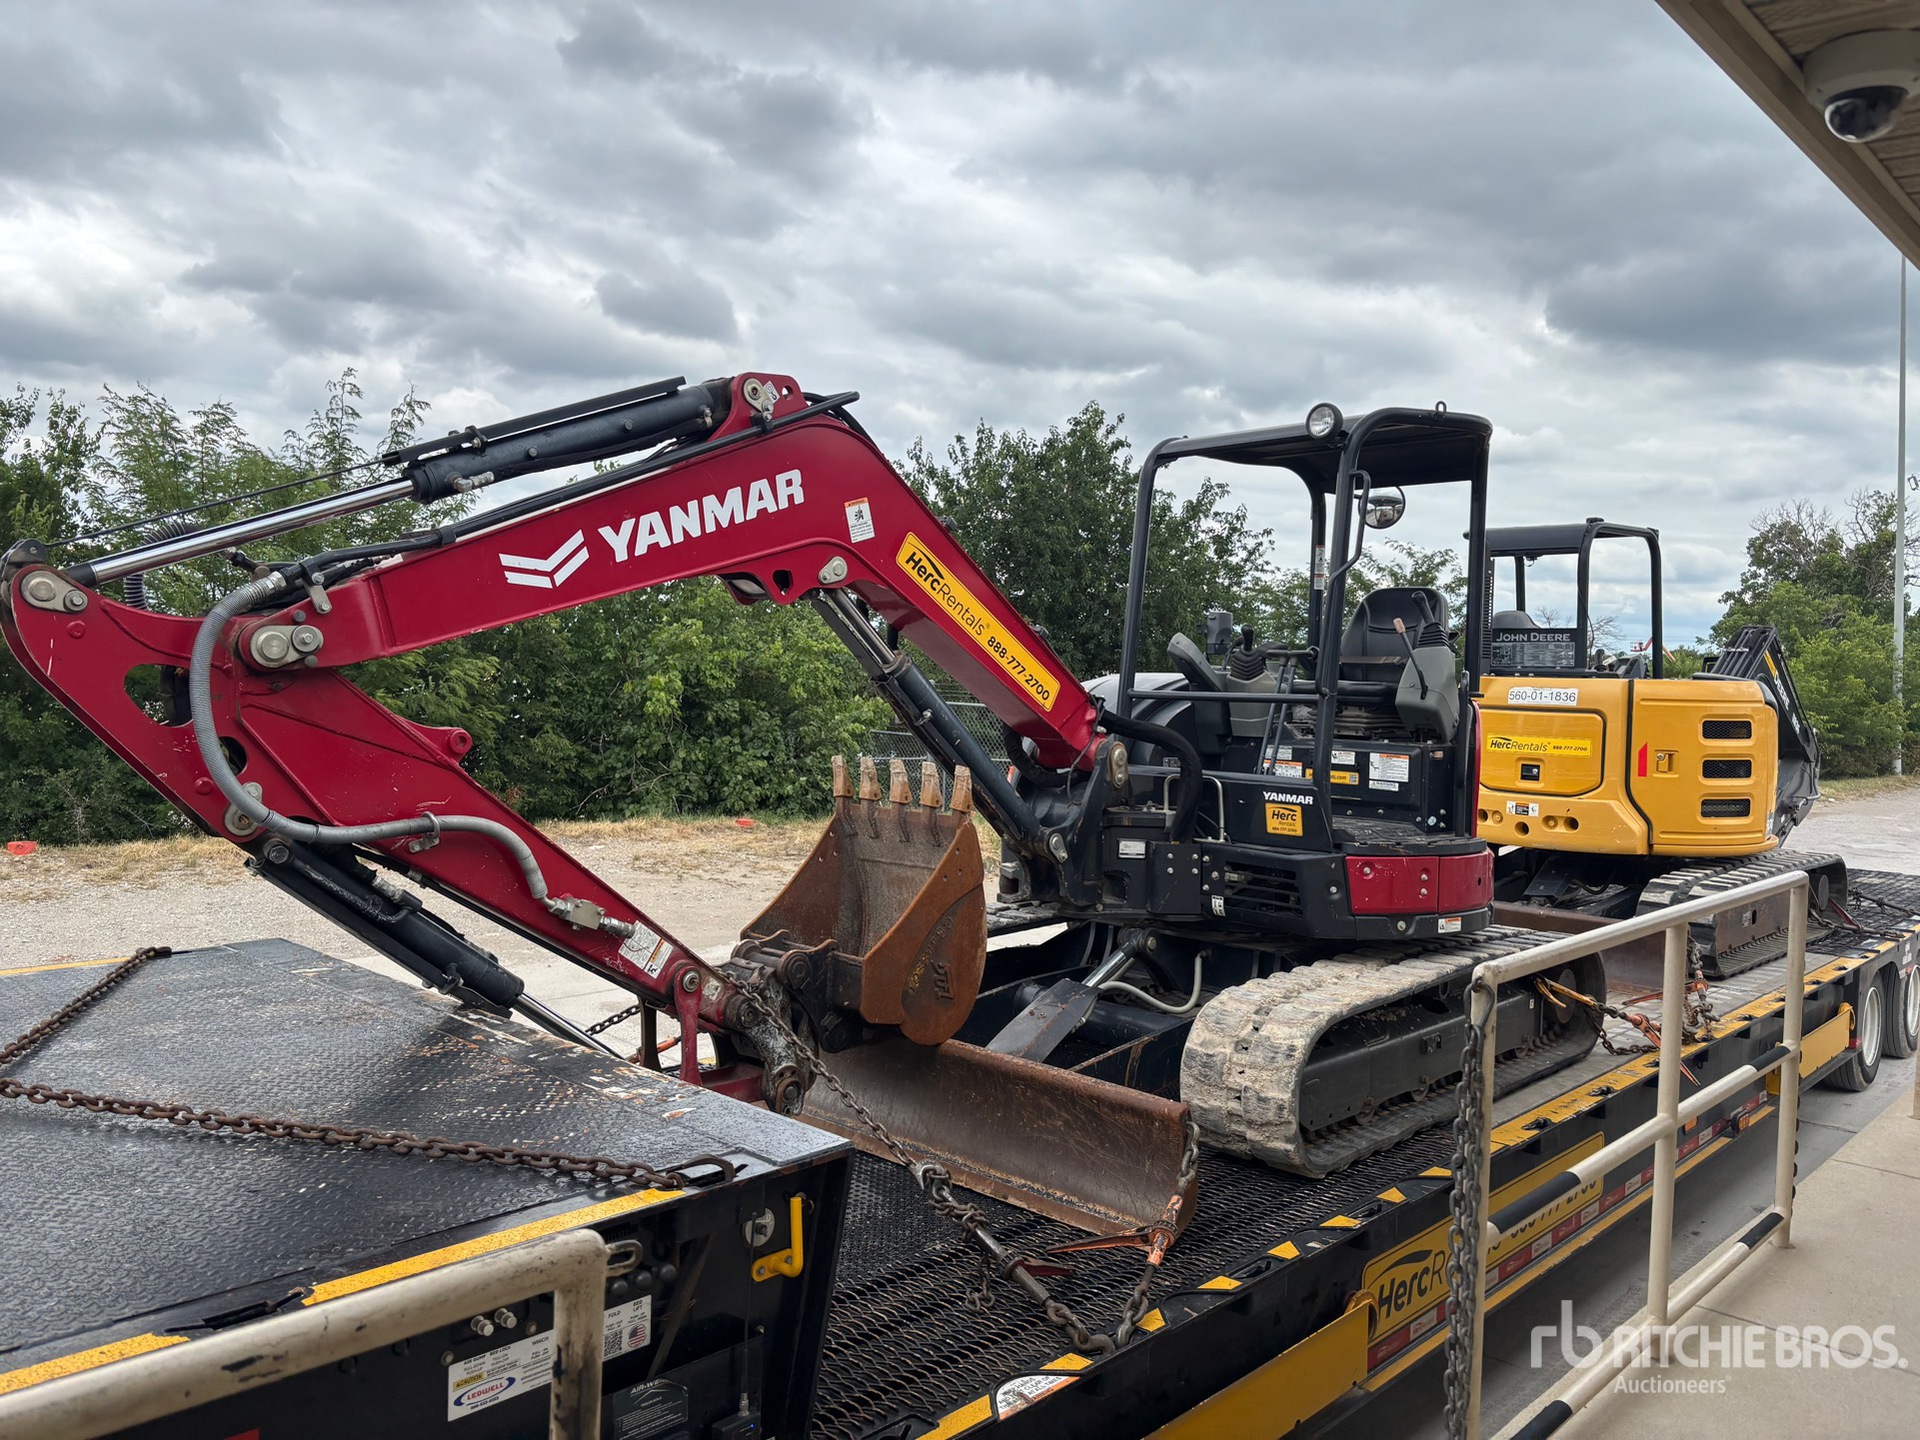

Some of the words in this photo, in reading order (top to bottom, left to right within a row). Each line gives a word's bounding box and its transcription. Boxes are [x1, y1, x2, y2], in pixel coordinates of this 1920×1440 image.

[598, 469, 804, 562] YANMAR
[1496, 632, 1527, 642] JOHN
[1530, 632, 1571, 642] DEERE
[987, 635, 1051, 701] 888-777-2700
[1508, 690, 1577, 702] 560-01-1836
[1773, 670, 1790, 711] DEERE
[1262, 790, 1314, 805] YANMAR
[1271, 809, 1298, 822] Herc
[459, 1373, 483, 1387] CAUTION
[467, 1382, 504, 1400] LEDWELL
